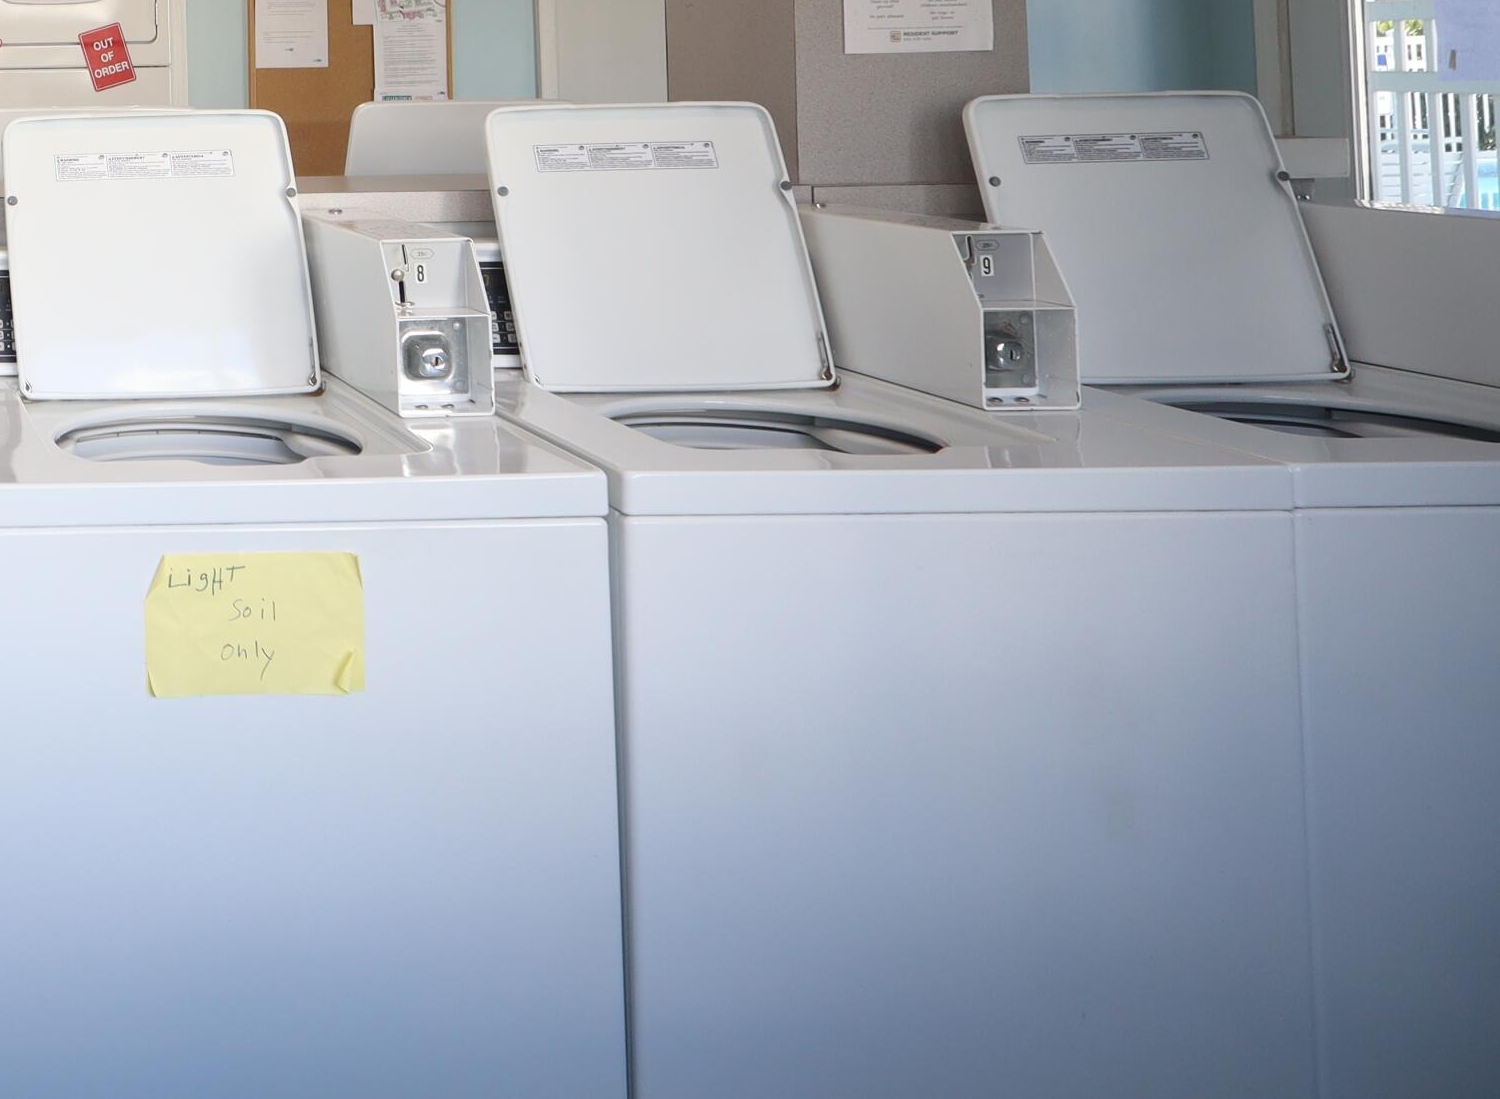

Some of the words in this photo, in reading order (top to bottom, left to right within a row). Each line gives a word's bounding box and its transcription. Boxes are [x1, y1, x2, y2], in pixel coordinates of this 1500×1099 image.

[93, 37, 114, 51] OUT
[101, 52, 115, 63] OF
[94, 61, 129, 79] ORDER
[417, 265, 424, 282] 8
[983, 257, 991, 274] 9
